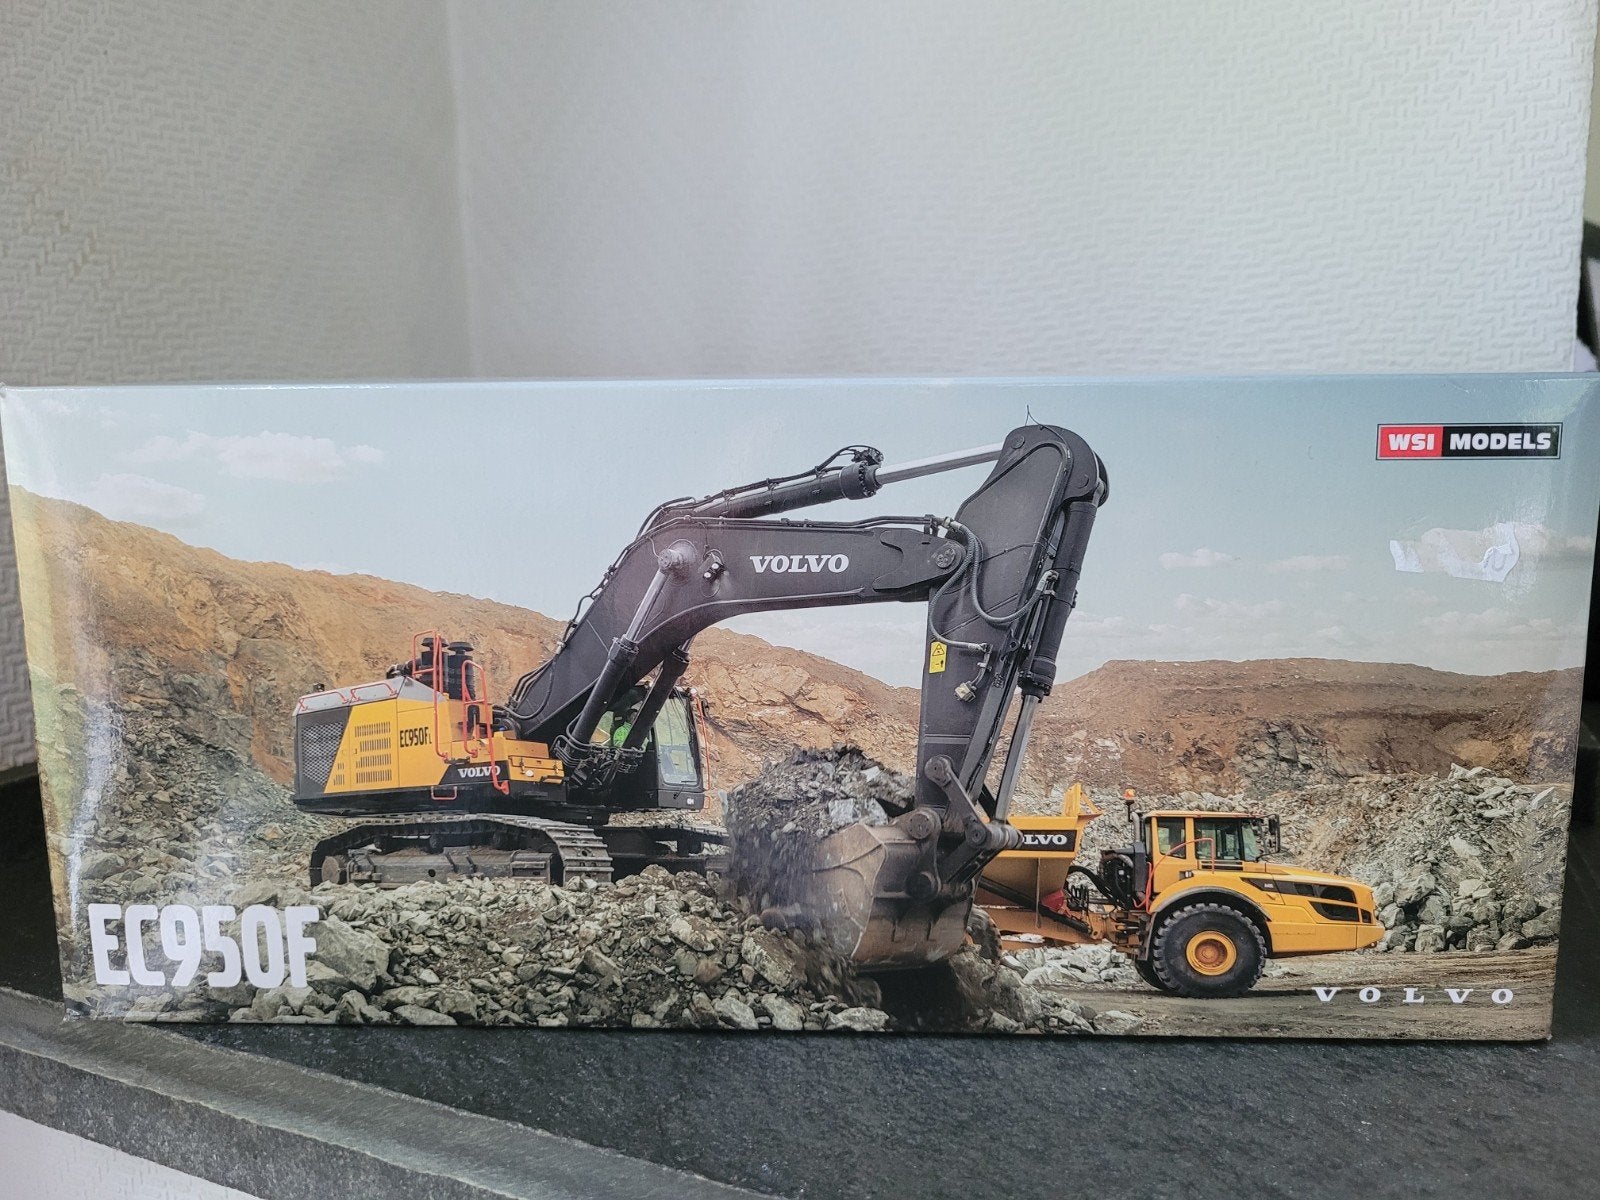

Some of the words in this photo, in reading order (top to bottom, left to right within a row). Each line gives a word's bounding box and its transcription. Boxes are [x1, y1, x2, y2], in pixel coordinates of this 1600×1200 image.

[1388, 433, 1435, 451] WSI
[1449, 432, 1551, 450] MODELS
[749, 553, 850, 574] VOLVO
[457, 765, 501, 778] VOLVO
[1022, 834, 1067, 845] LVO
[88, 902, 320, 989] EC950F
[1311, 986, 1514, 1004] VOLVO
